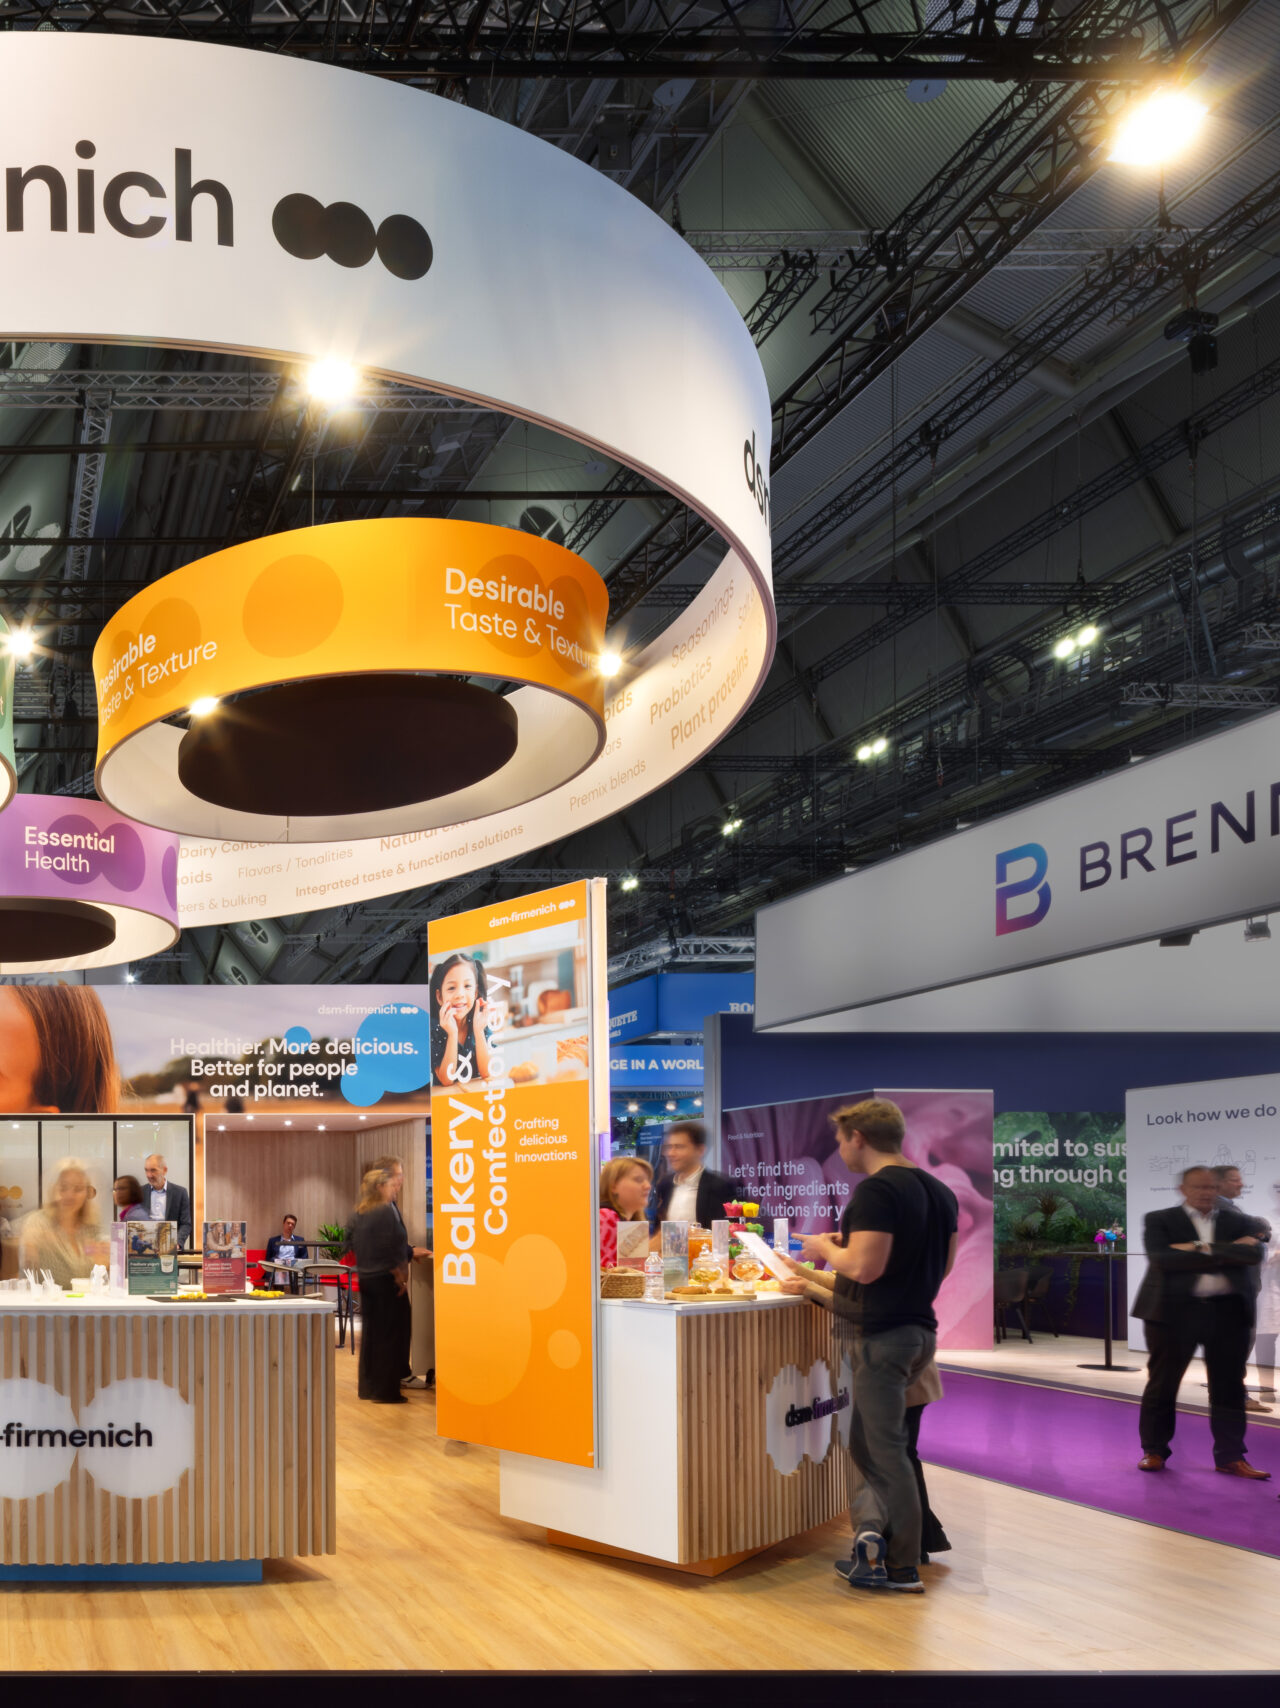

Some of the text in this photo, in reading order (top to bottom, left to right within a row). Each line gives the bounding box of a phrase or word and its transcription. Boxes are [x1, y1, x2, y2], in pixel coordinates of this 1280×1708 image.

[445, 567, 565, 620] Desirable
[444, 603, 518, 638] Taste
[524, 618, 542, 645] &
[672, 579, 735, 669] Seasonings
[100, 634, 157, 702] Desirable
[124, 675, 135, 700] &
[138, 641, 218, 688] Texture
[650, 655, 713, 725] Probiotics
[671, 704, 706, 750] Plant
[708, 648, 749, 723] proteins
[569, 760, 647, 811] Premix blends
[24, 826, 115, 854] Essential
[24, 851, 90, 874] Health
[180, 844, 218, 860] Dairy
[238, 862, 283, 879] Flavors
[296, 848, 353, 868] Tonalities
[296, 876, 360, 897] Integrated
[362, 867, 394, 883] taste
[396, 863, 406, 875] &
[408, 845, 470, 871] functional
[472, 825, 524, 852] solutions
[209, 898, 219, 910] &
[222, 893, 268, 909] bulking
[489, 902, 557, 928] dsm-firmenich
[318, 1004, 397, 1015] dsm-firmenich
[170, 1038, 419, 1055] Healthier. More delicious.
[191, 1059, 358, 1080] Better for people
[632, 1059, 645, 1070] IN
[648, 1059, 659, 1070] A
[210, 1080, 324, 1101] and planet.
[483, 974, 511, 1235] Confectionery
[1146, 1104, 1277, 1126] Look how we do
[514, 1117, 559, 1132] Crafting
[519, 1132, 568, 1147] delicious
[1064, 1139, 1089, 1157] to
[514, 1148, 578, 1163] Innovations
[440, 1051, 484, 1285] Bakery &
[728, 1161, 805, 1178] Let's find the
[1020, 1165, 1113, 1188] through
[774, 1180, 850, 1200] ingredients
[813, 1201, 833, 1217] for
